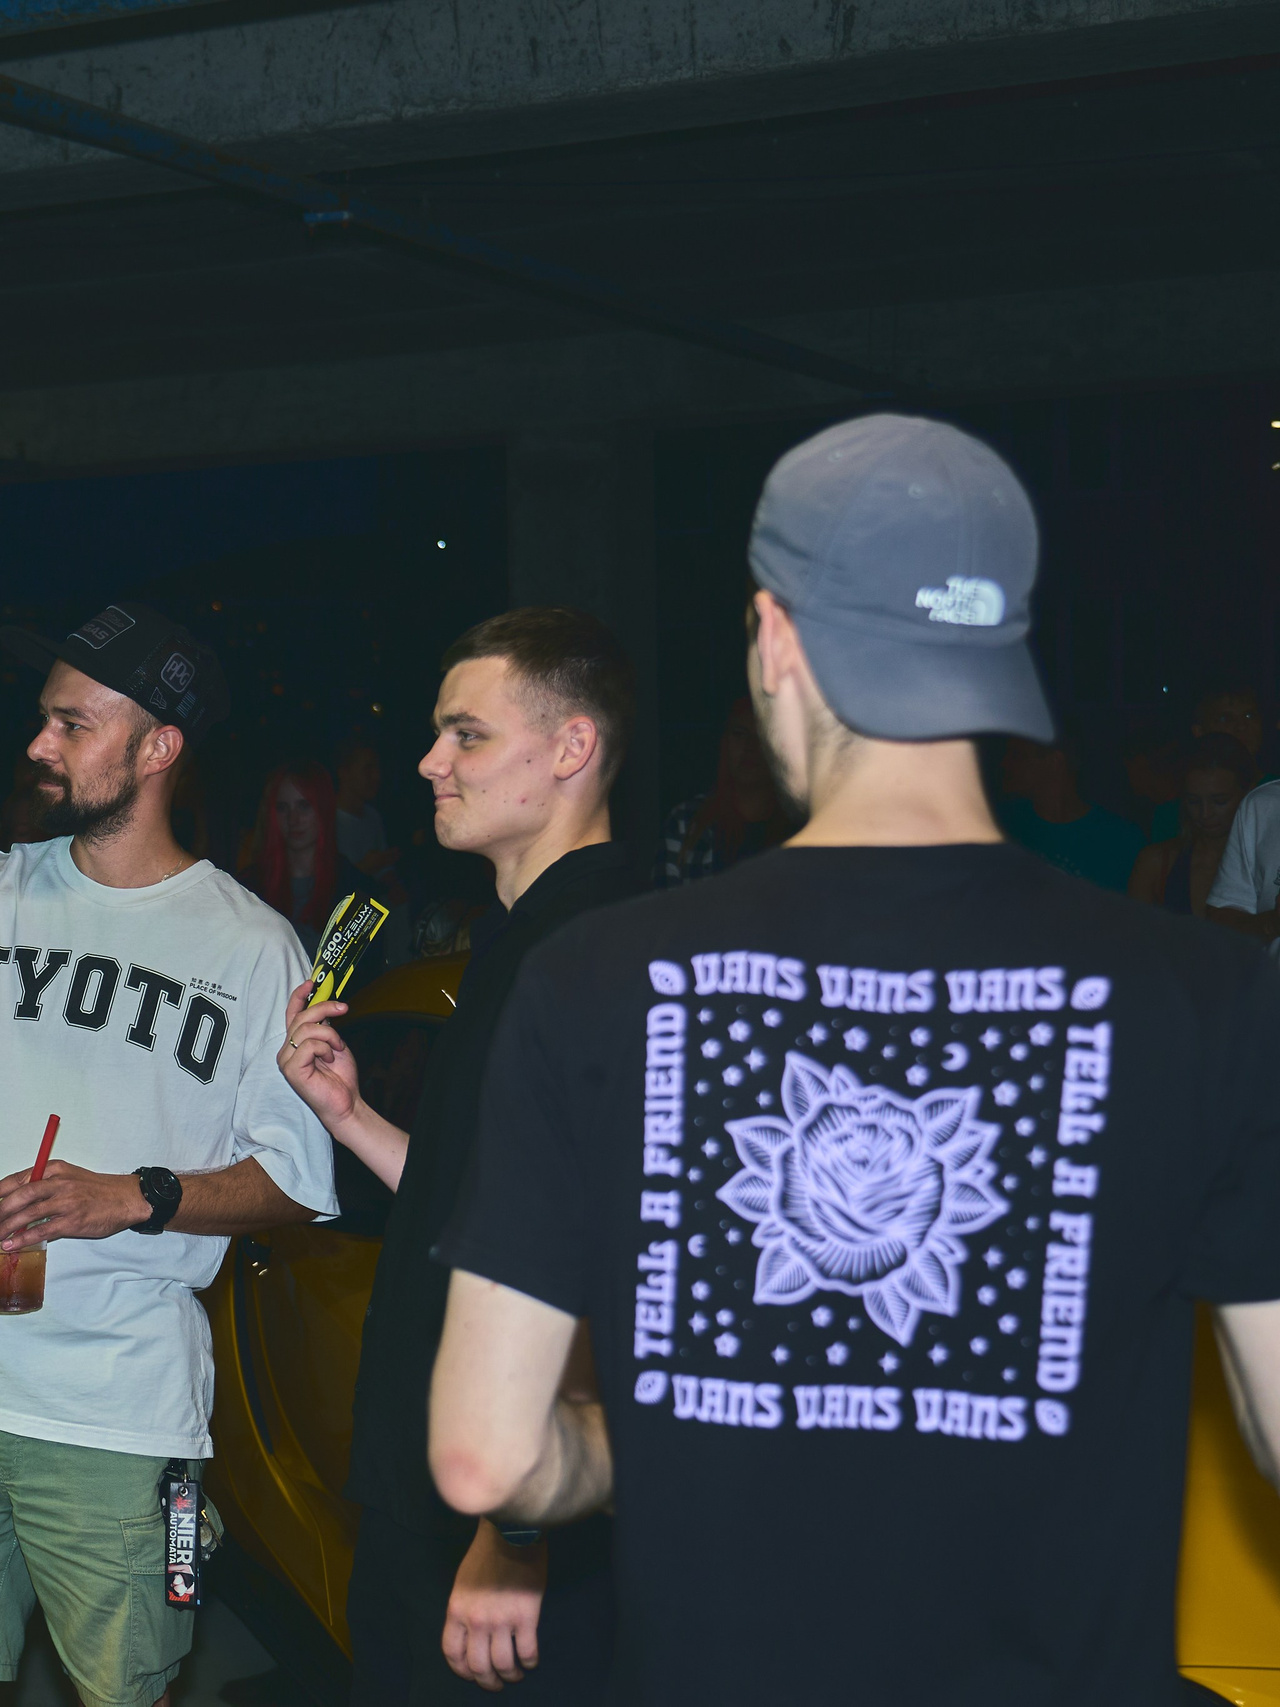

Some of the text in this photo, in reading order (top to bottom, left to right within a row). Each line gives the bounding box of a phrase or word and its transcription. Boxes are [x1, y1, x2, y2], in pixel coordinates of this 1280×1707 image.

[166, 660, 191, 686] PPG
[322, 932, 343, 961] 500
[189, 982, 208, 993] PLACE
[216, 991, 238, 1002] WISDOM
[690, 951, 1067, 1014] VANS VANS VANS
[642, 1002, 688, 1178] FRIEND
[1056, 1021, 1113, 1146] TELL
[633, 1240, 679, 1359] TELL
[1035, 1210, 1093, 1393] FRIEND
[671, 1374, 1029, 1442] VANS VANS VANS
[168, 1511, 177, 1564] AUTOMATA
[176, 1512, 195, 1565] NIER
